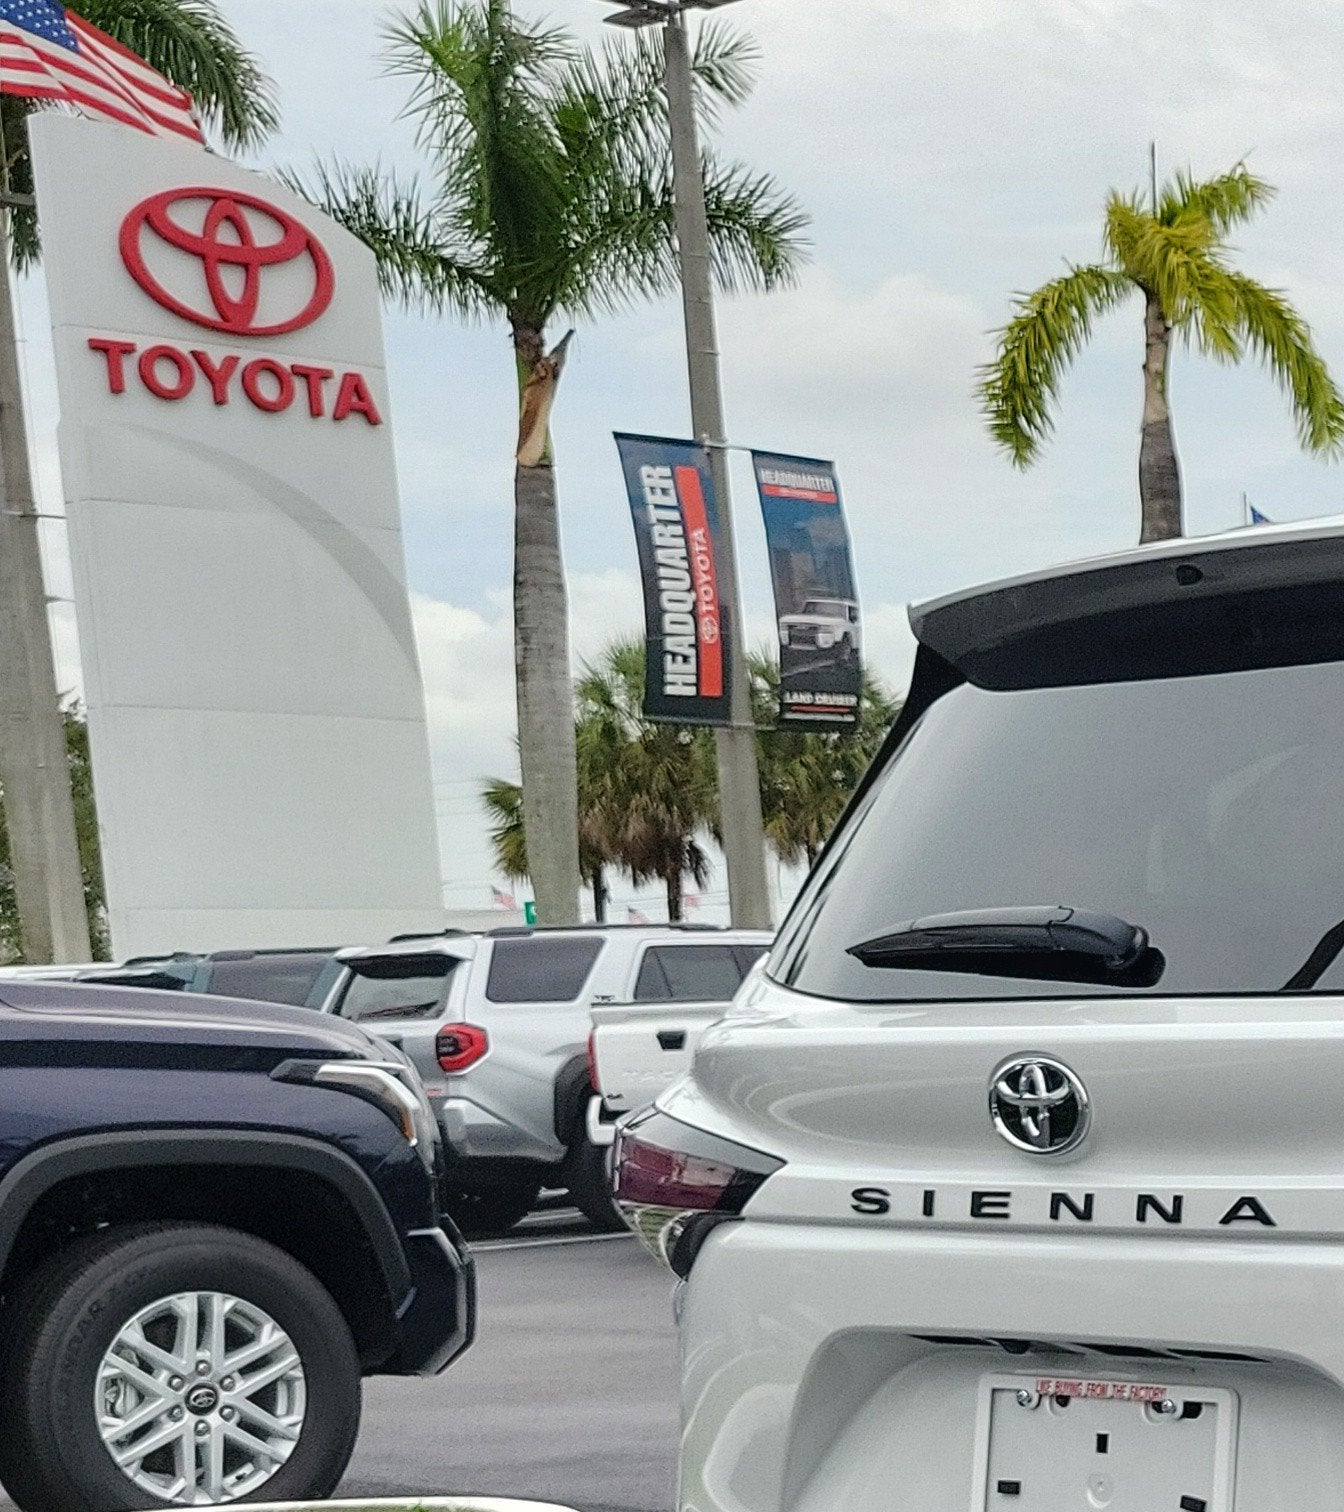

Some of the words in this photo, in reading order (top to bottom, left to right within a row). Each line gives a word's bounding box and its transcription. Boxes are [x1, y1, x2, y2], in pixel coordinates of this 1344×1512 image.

[88, 338, 382, 425] TOYOTA
[641, 464, 698, 697] HEADQUARTER
[690, 528, 715, 613] TOYOTA
[851, 1187, 1277, 1227] SIENNA
[1086, 1382, 1109, 1399] FROM
[1112, 1384, 1128, 1400] THE
